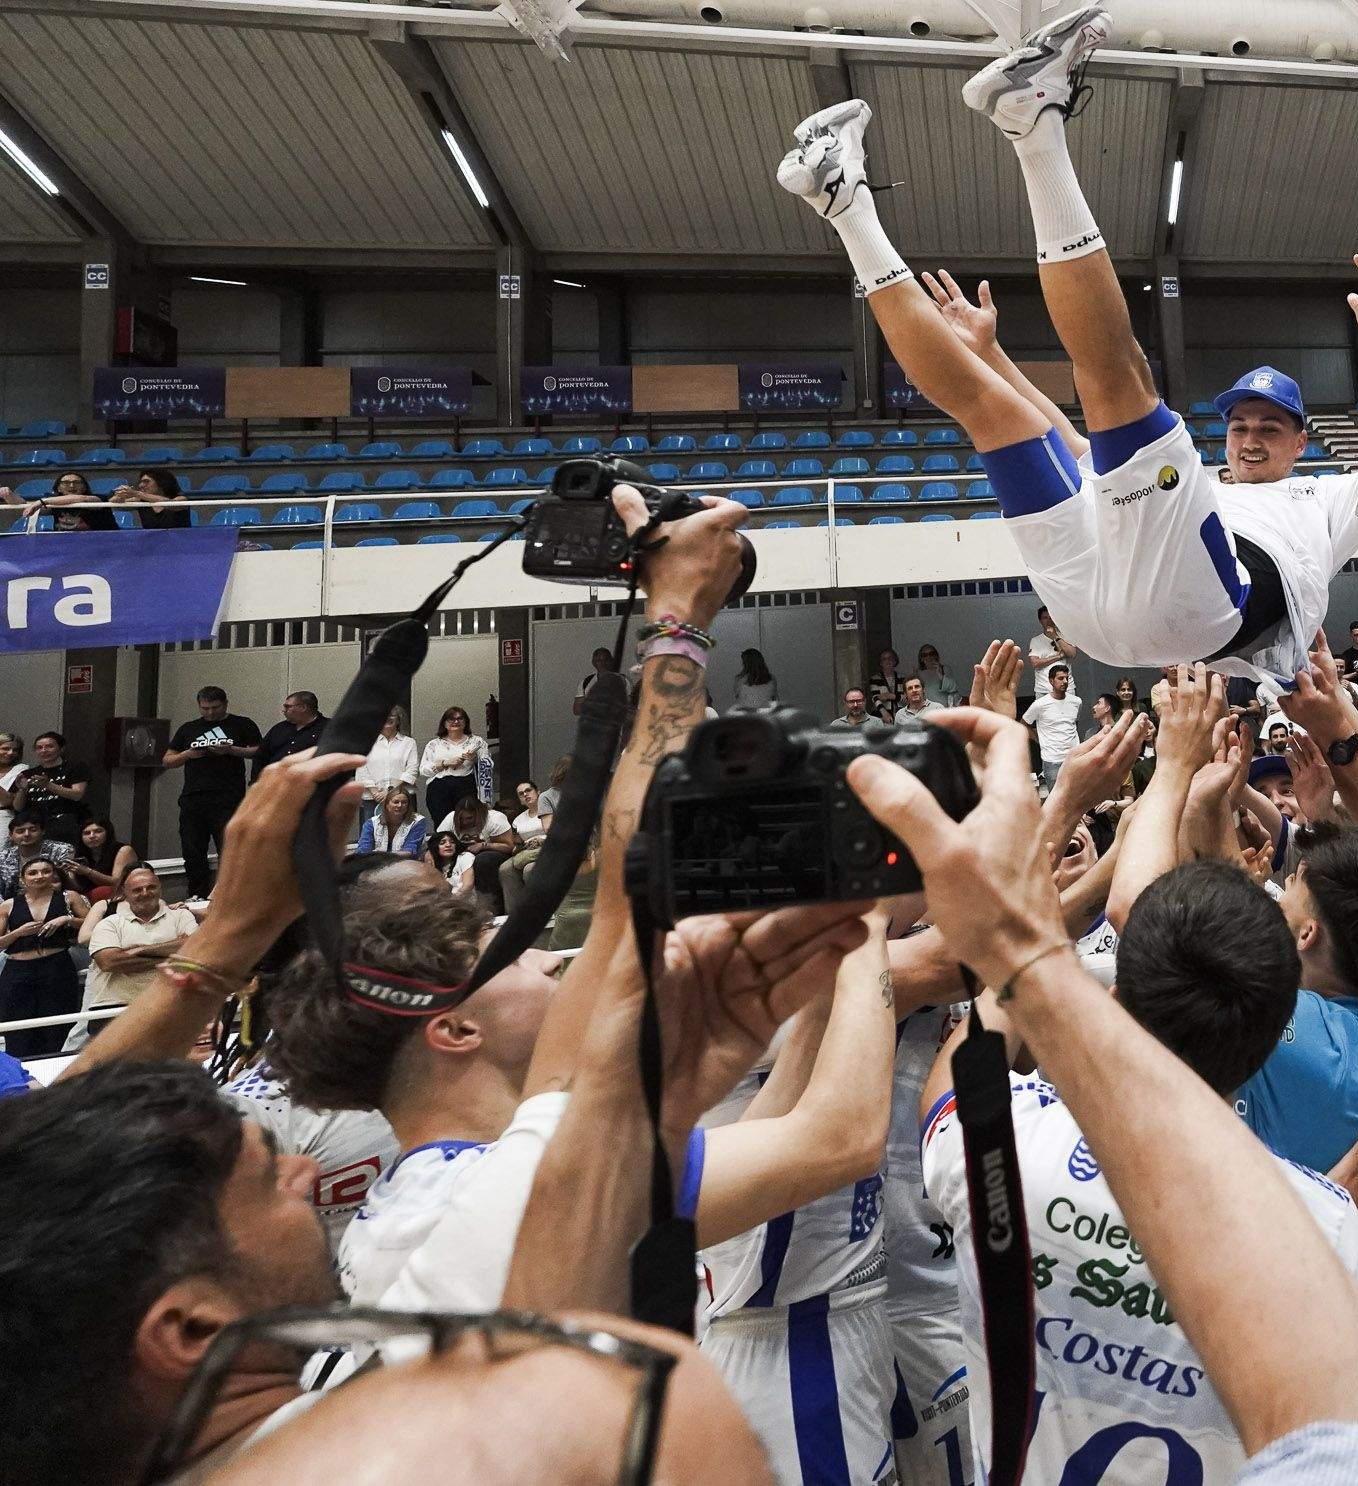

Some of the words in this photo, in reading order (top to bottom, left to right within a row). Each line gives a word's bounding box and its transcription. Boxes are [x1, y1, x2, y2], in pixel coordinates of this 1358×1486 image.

[87, 272, 107, 281] CC
[140, 383, 200, 391] PONTEVEDRA
[394, 382, 448, 390] PONTEVEDRA
[559, 381, 609, 389] PONTEVEDRA
[7, 573, 112, 630] ra
[839, 607, 854, 622] C
[190, 737, 235, 749] adidas
[347, 971, 434, 1007] anon
[981, 1149, 1014, 1252] Canon
[1035, 1316, 1204, 1398] Costas
